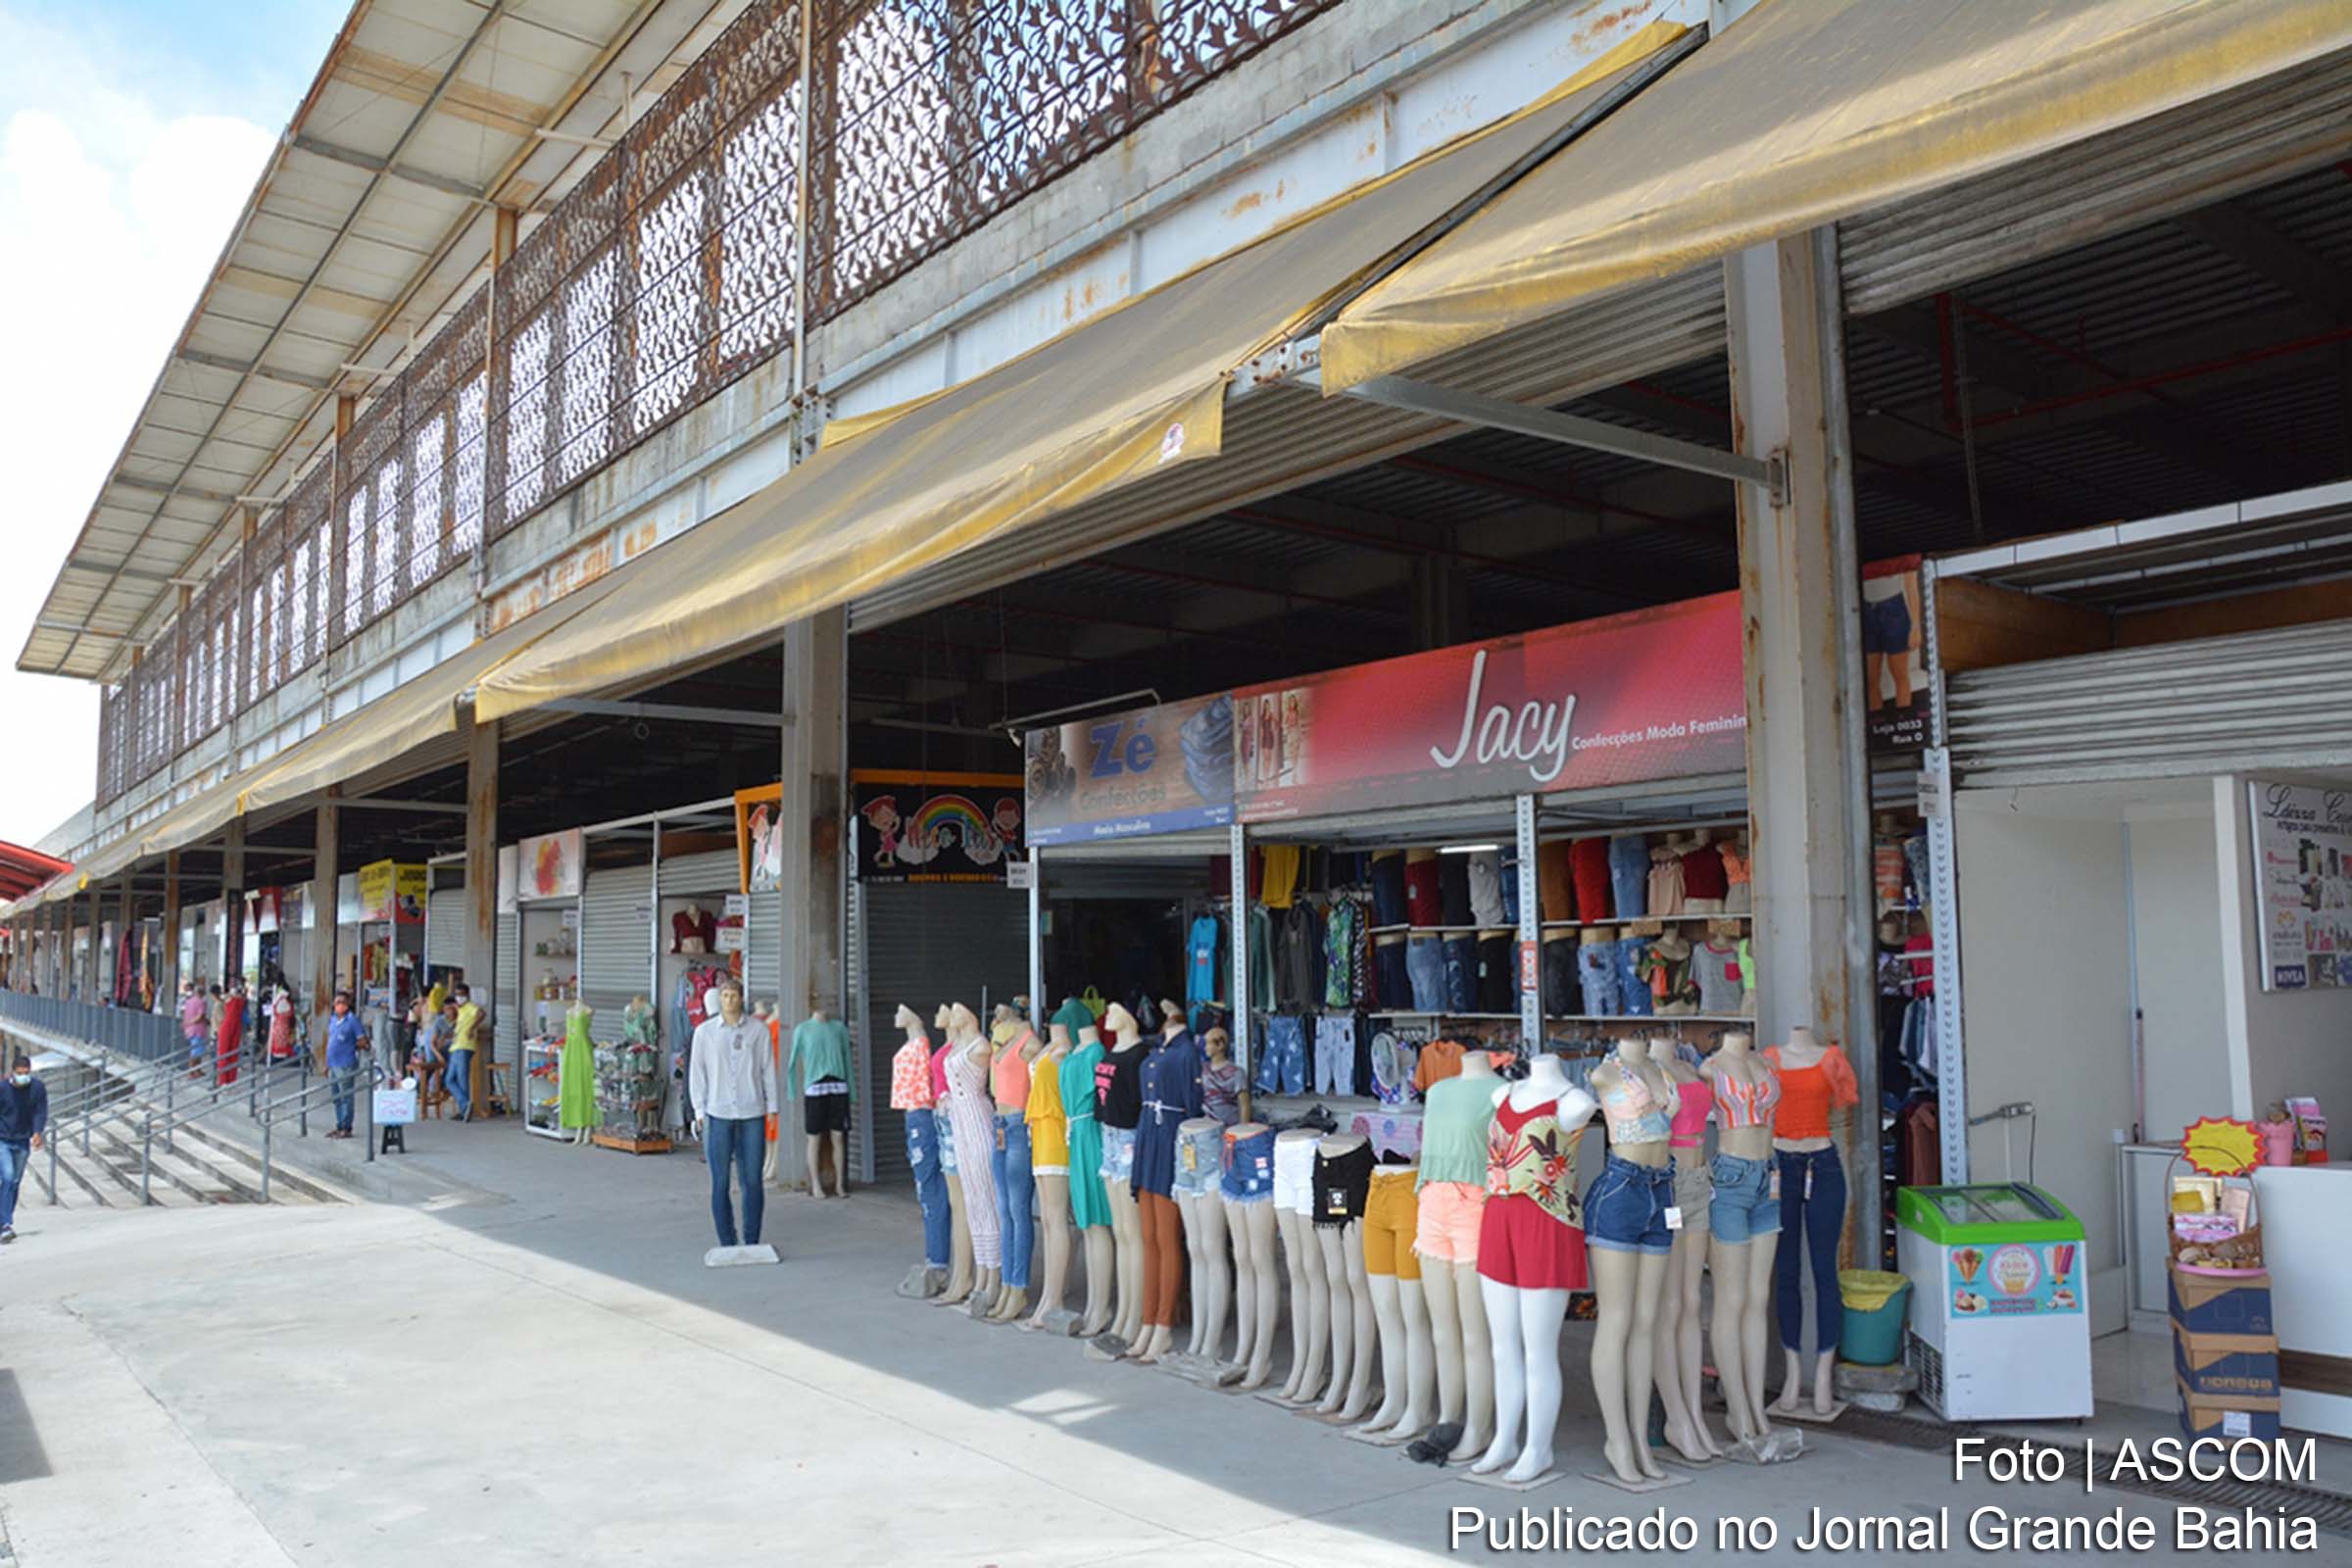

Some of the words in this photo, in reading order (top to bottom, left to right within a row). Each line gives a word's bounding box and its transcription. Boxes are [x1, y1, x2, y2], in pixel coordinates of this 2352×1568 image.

[1430, 650, 1576, 782] Jacy
[1571, 729, 1643, 752] Confecções
[1646, 723, 1686, 741] Moda
[1690, 713, 1747, 734] Feminin
[1091, 717, 1156, 778] Zé
[1081, 783, 1166, 810] Confecções
[2277, 970, 2305, 983] NIVEA
